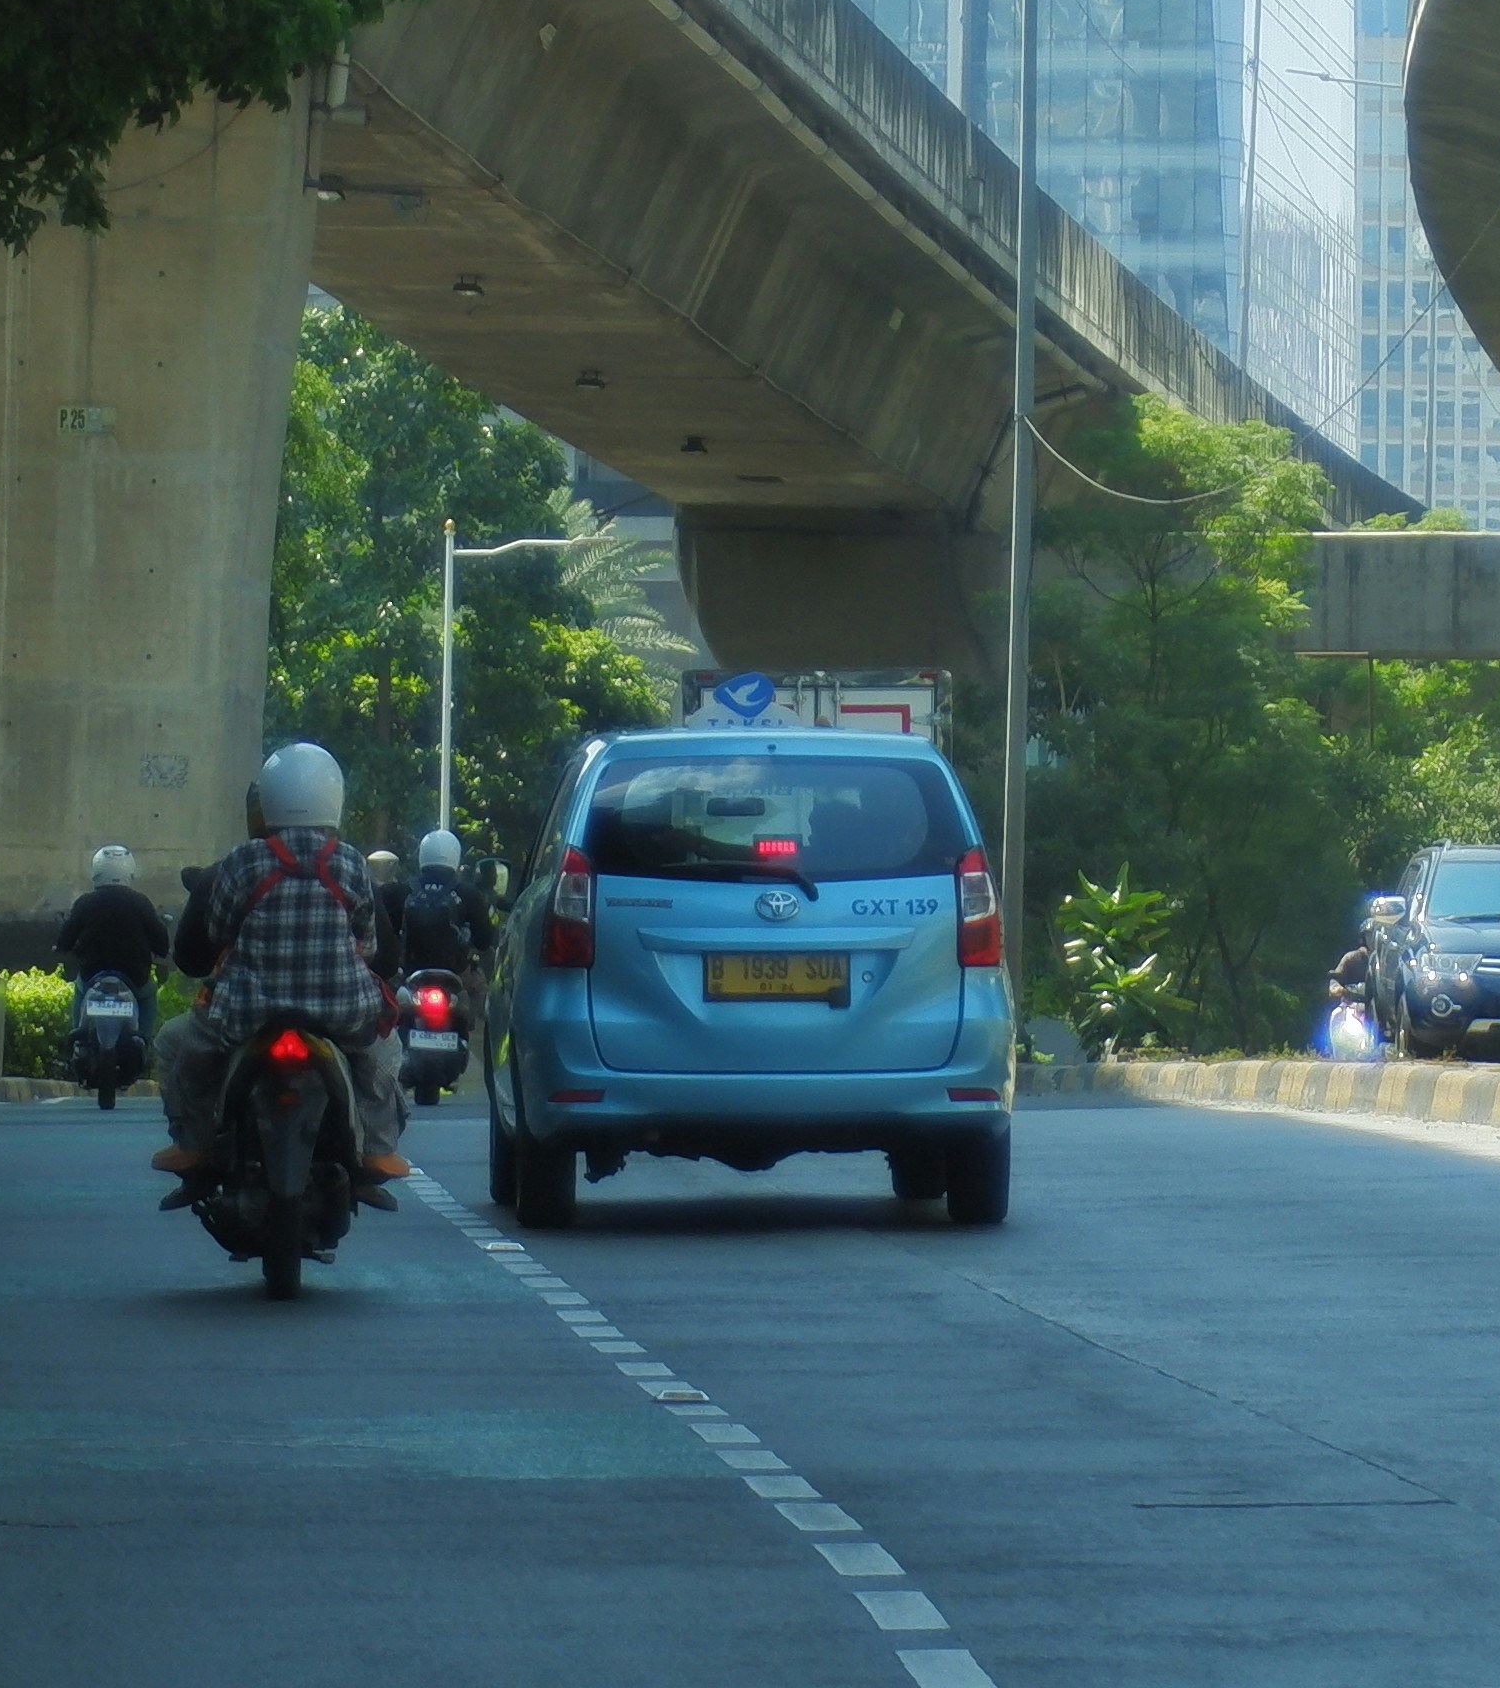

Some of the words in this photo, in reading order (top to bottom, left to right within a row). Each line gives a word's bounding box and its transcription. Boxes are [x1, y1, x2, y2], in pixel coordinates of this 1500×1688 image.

[851, 898, 899, 915] GXT
[905, 898, 938, 915] 139
[711, 957, 724, 980] B
[741, 957, 789, 980] 1939
